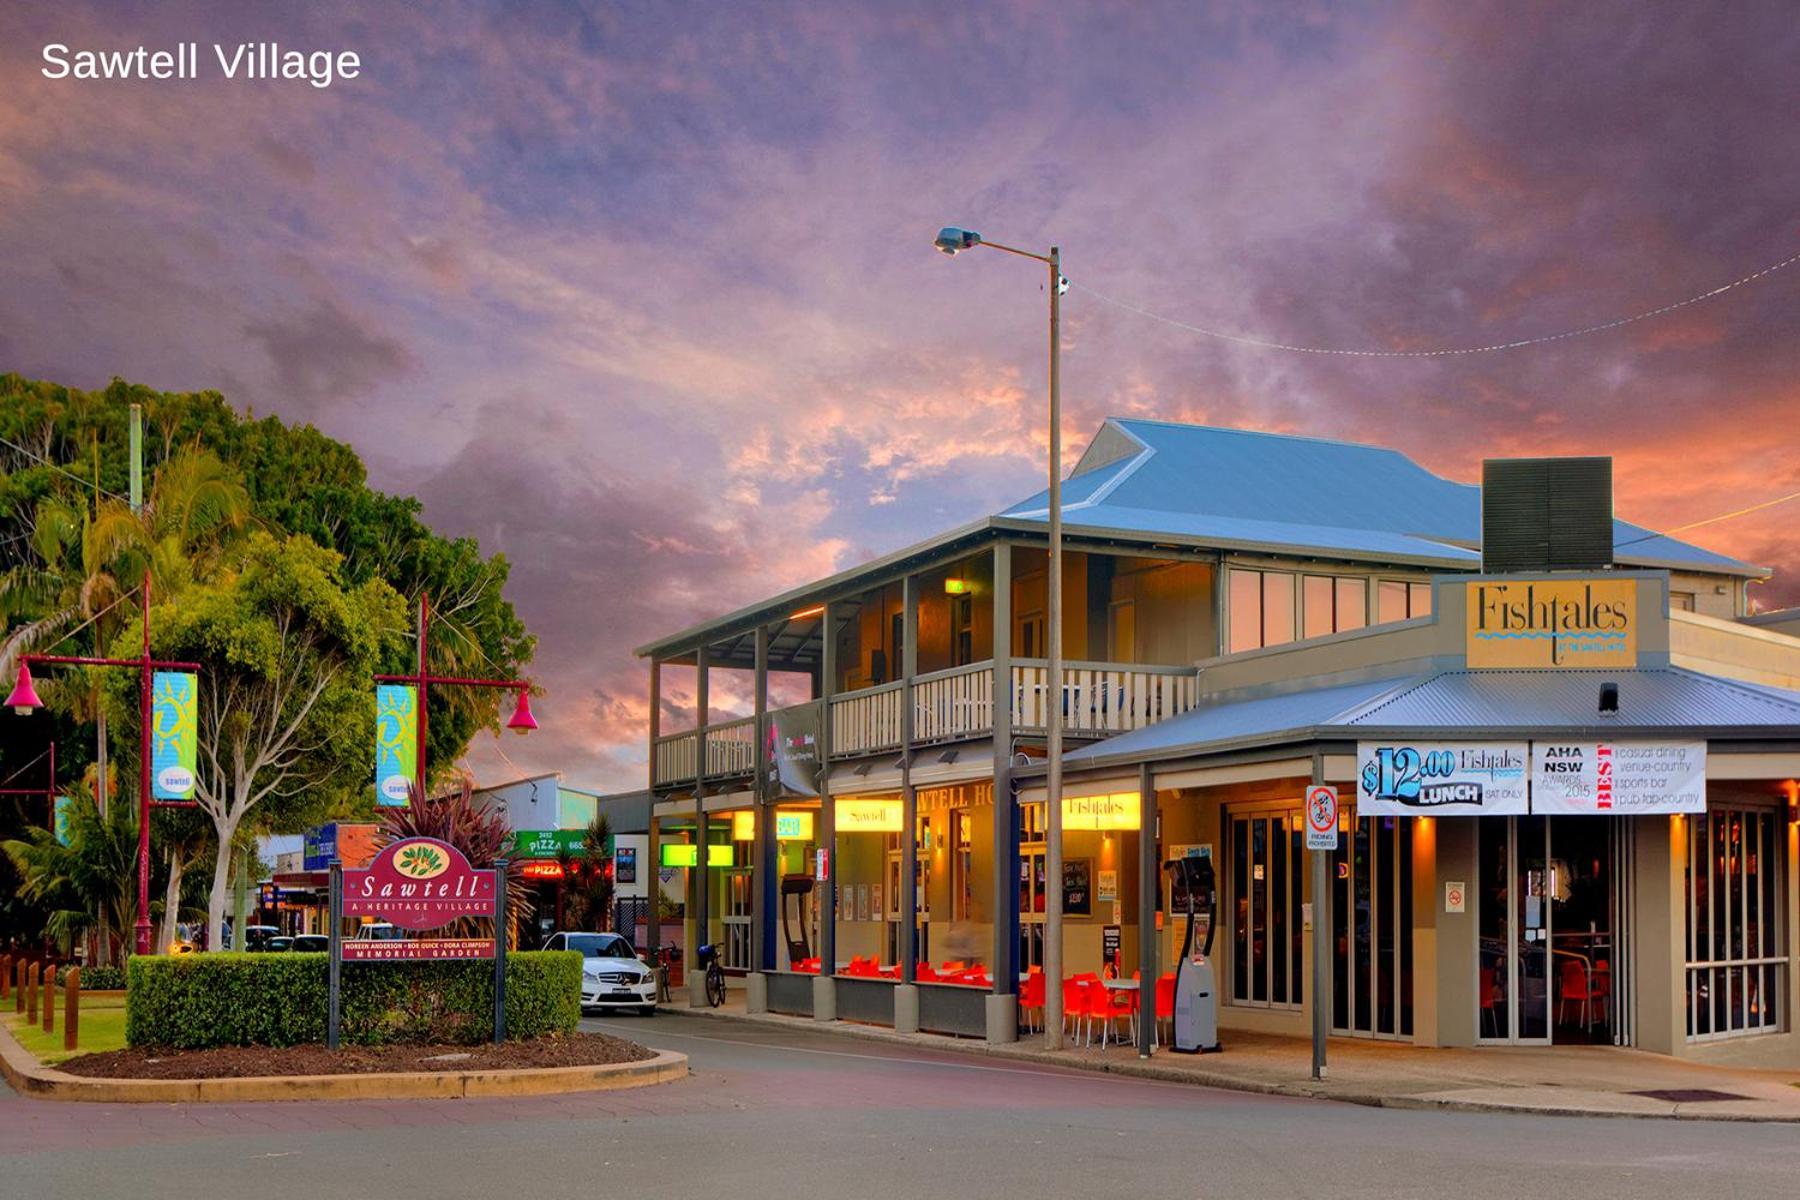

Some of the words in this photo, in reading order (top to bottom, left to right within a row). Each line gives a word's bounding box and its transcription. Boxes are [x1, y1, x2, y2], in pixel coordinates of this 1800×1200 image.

[1475, 584, 1628, 665] Fishtales
[1545, 747, 1583, 758] AHA
[1461, 749, 1523, 783] Fishtales
[1544, 762, 1583, 773] NSW
[1362, 747, 1455, 801] $12.00
[1597, 744, 1612, 809] BEST
[1651, 777, 1667, 787] bar
[1419, 786, 1478, 804] LUNCH
[1565, 785, 1591, 798] 2015
[850, 807, 887, 823] Sawtell
[534, 865, 562, 875] PIZZA
[361, 876, 478, 897] Sawtell
[352, 903, 359, 911] A
[366, 903, 429, 911] HERITAGE
[436, 903, 488, 911] VILLAGE
[356, 950, 422, 958] MEMORIAL
[432, 949, 480, 957] GARDEN
